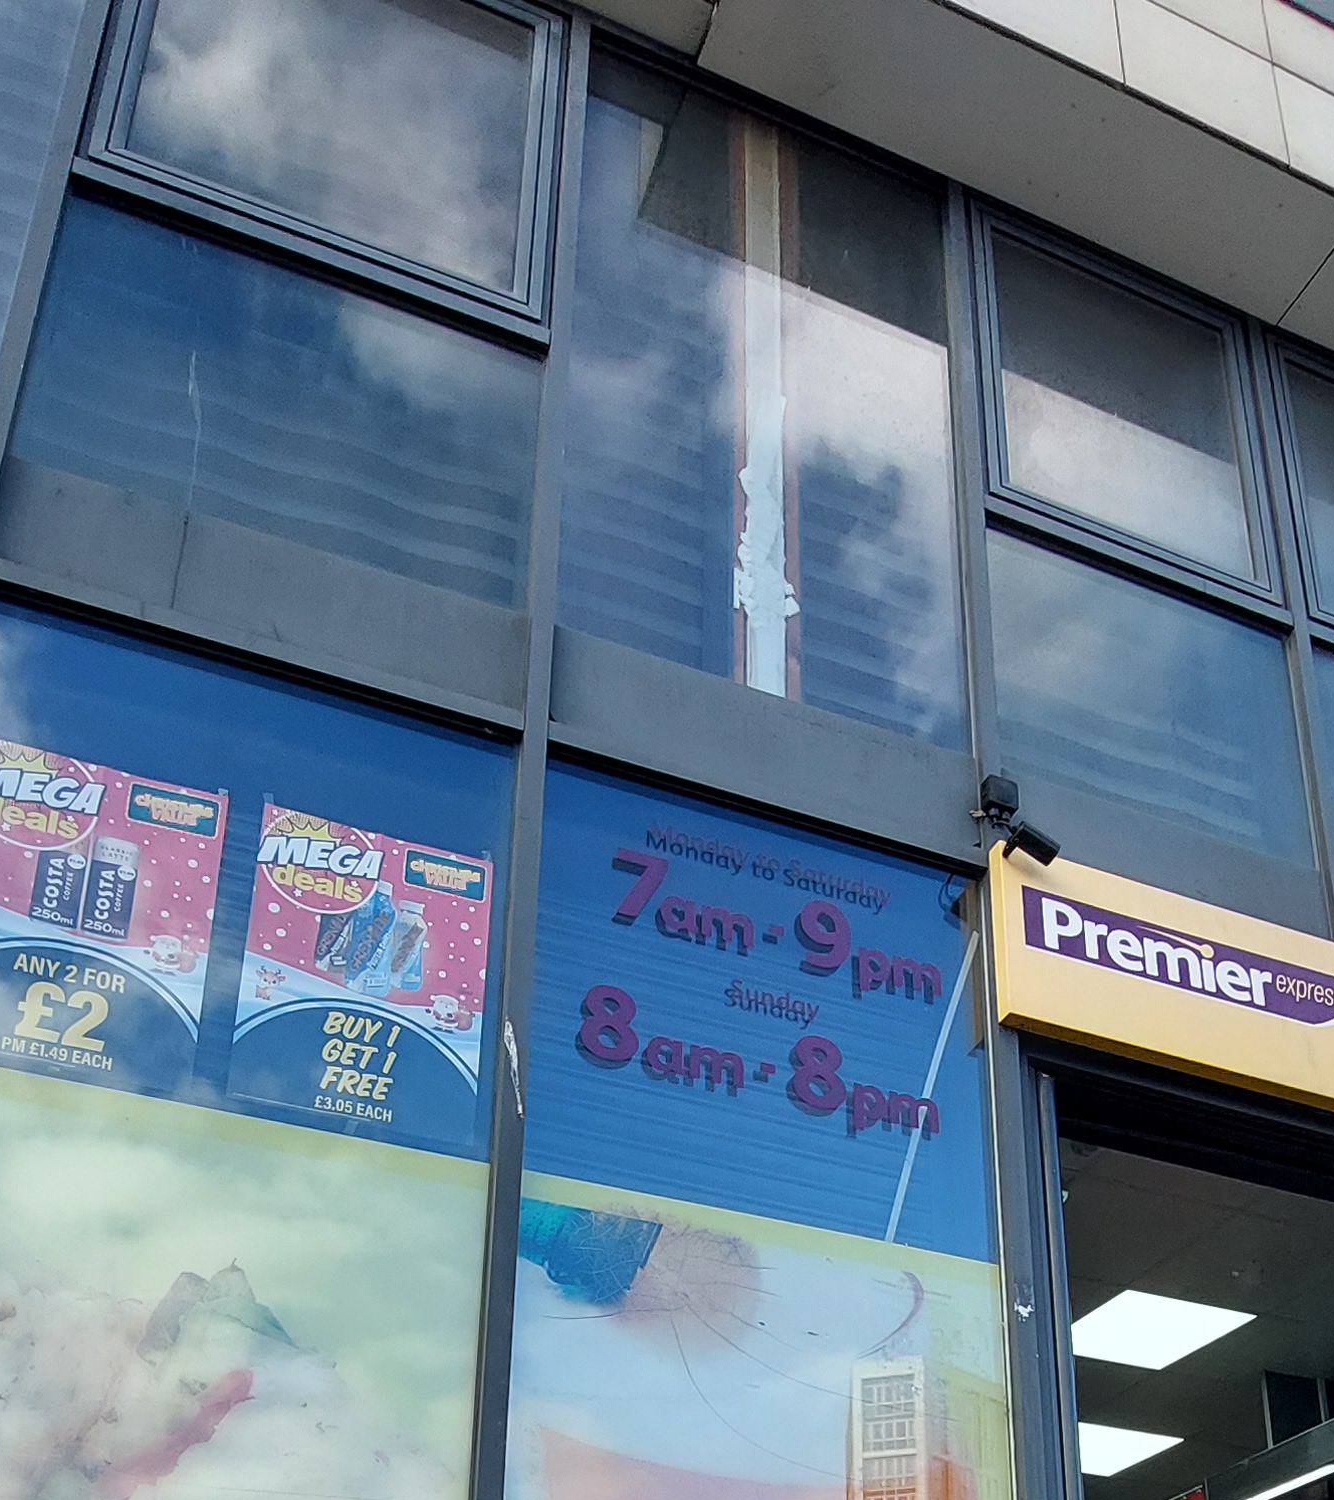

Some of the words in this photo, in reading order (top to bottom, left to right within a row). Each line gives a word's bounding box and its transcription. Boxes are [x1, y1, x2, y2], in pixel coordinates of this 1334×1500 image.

[256, 835, 383, 881] MEGA
[646, 824, 749, 877] Monday
[751, 848, 780, 881] to
[783, 859, 892, 915] Saturday
[42, 857, 66, 909] COSTA
[94, 870, 116, 920] COSTA
[272, 863, 364, 903] deals
[31, 906, 74, 926] 250ml
[83, 919, 125, 936] 250ml
[1040, 895, 1273, 1007] Premier
[13, 952, 58, 979] ANY
[63, 963, 78, 983] 2
[82, 966, 125, 994] FOR
[13, 980, 109, 1053] £2
[724, 979, 820, 1030] Sunday
[323, 1010, 377, 1042] BUY
[386, 1023, 401, 1047] 1
[0, 1036, 26, 1055] PM
[28, 1040, 69, 1063] £1.49
[71, 1050, 114, 1072] EACH
[321, 1038, 377, 1071] GET
[381, 1050, 395, 1074] 1
[321, 1064, 395, 1102] FREE
[314, 1095, 354, 1117] £3.05
[355, 1099, 394, 1124] EACH
